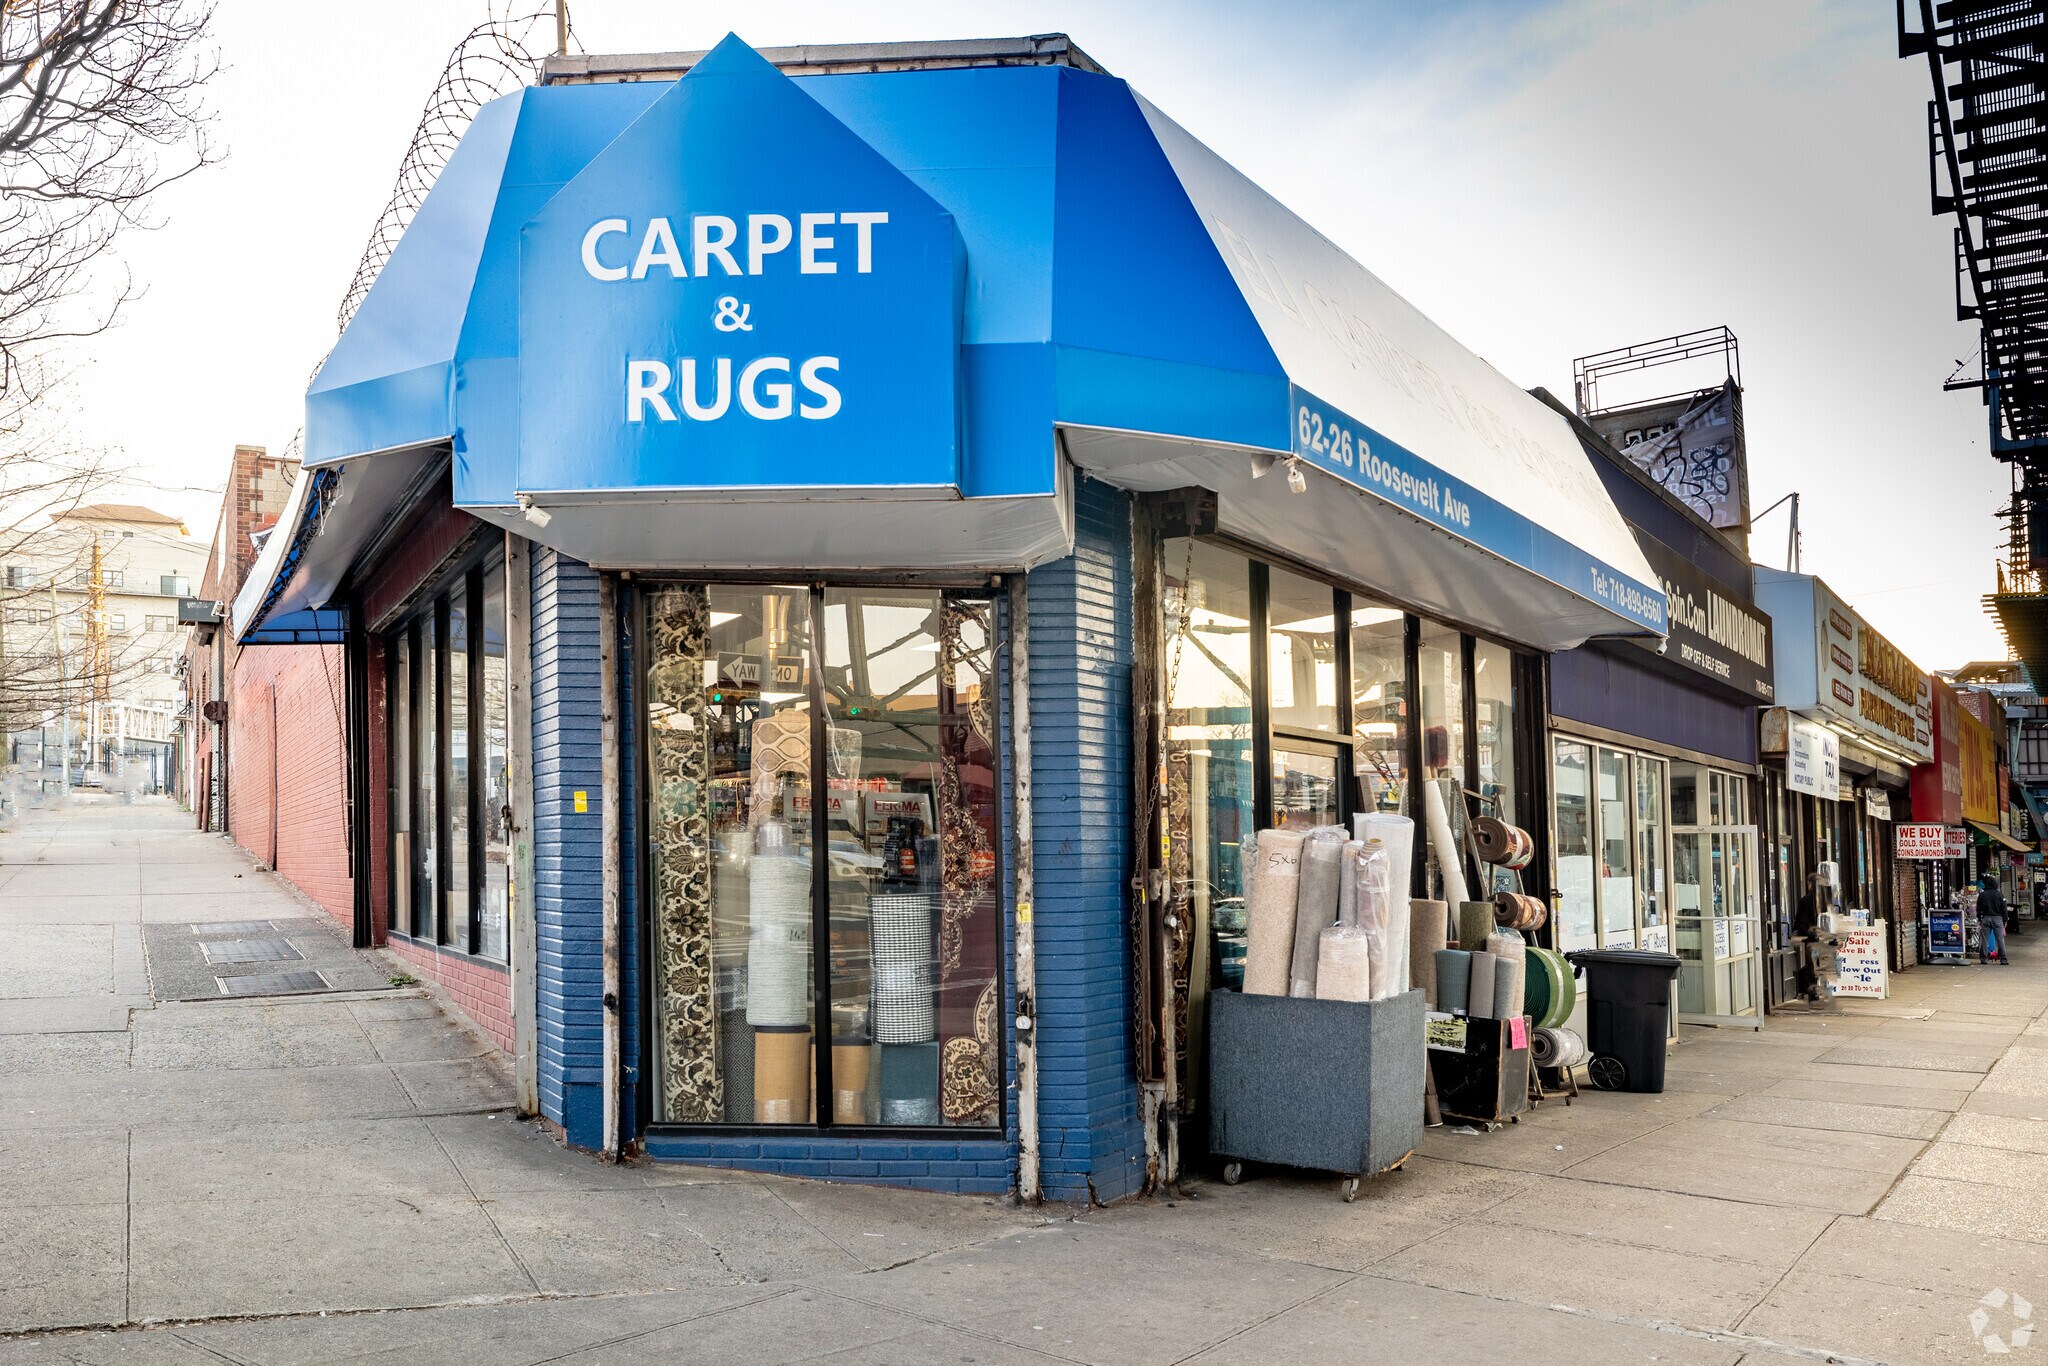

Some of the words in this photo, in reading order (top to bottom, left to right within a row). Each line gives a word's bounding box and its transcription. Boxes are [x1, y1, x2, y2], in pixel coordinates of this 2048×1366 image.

[580, 211, 889, 282] CARPET
[714, 296, 753, 332] &
[628, 356, 842, 423] RUGS
[1299, 406, 1353, 468] 62-26
[1358, 438, 1440, 513] Roosevelt
[1444, 487, 1471, 528] Ave
[1591, 567, 1608, 599] Tel:
[1609, 577, 1662, 624] 718-899-6560
[1666, 580, 1706, 636] Spin.Com
[1707, 589, 1766, 668] LAUNDROMAT
[1825, 761, 1835, 780] TAX
[1899, 827, 1916, 838] WE
[1919, 827, 1942, 839] BUY
[1919, 839, 1941, 848] SILVER
[1848, 937, 1870, 946] Sale
[1863, 966, 1882, 974] Out
